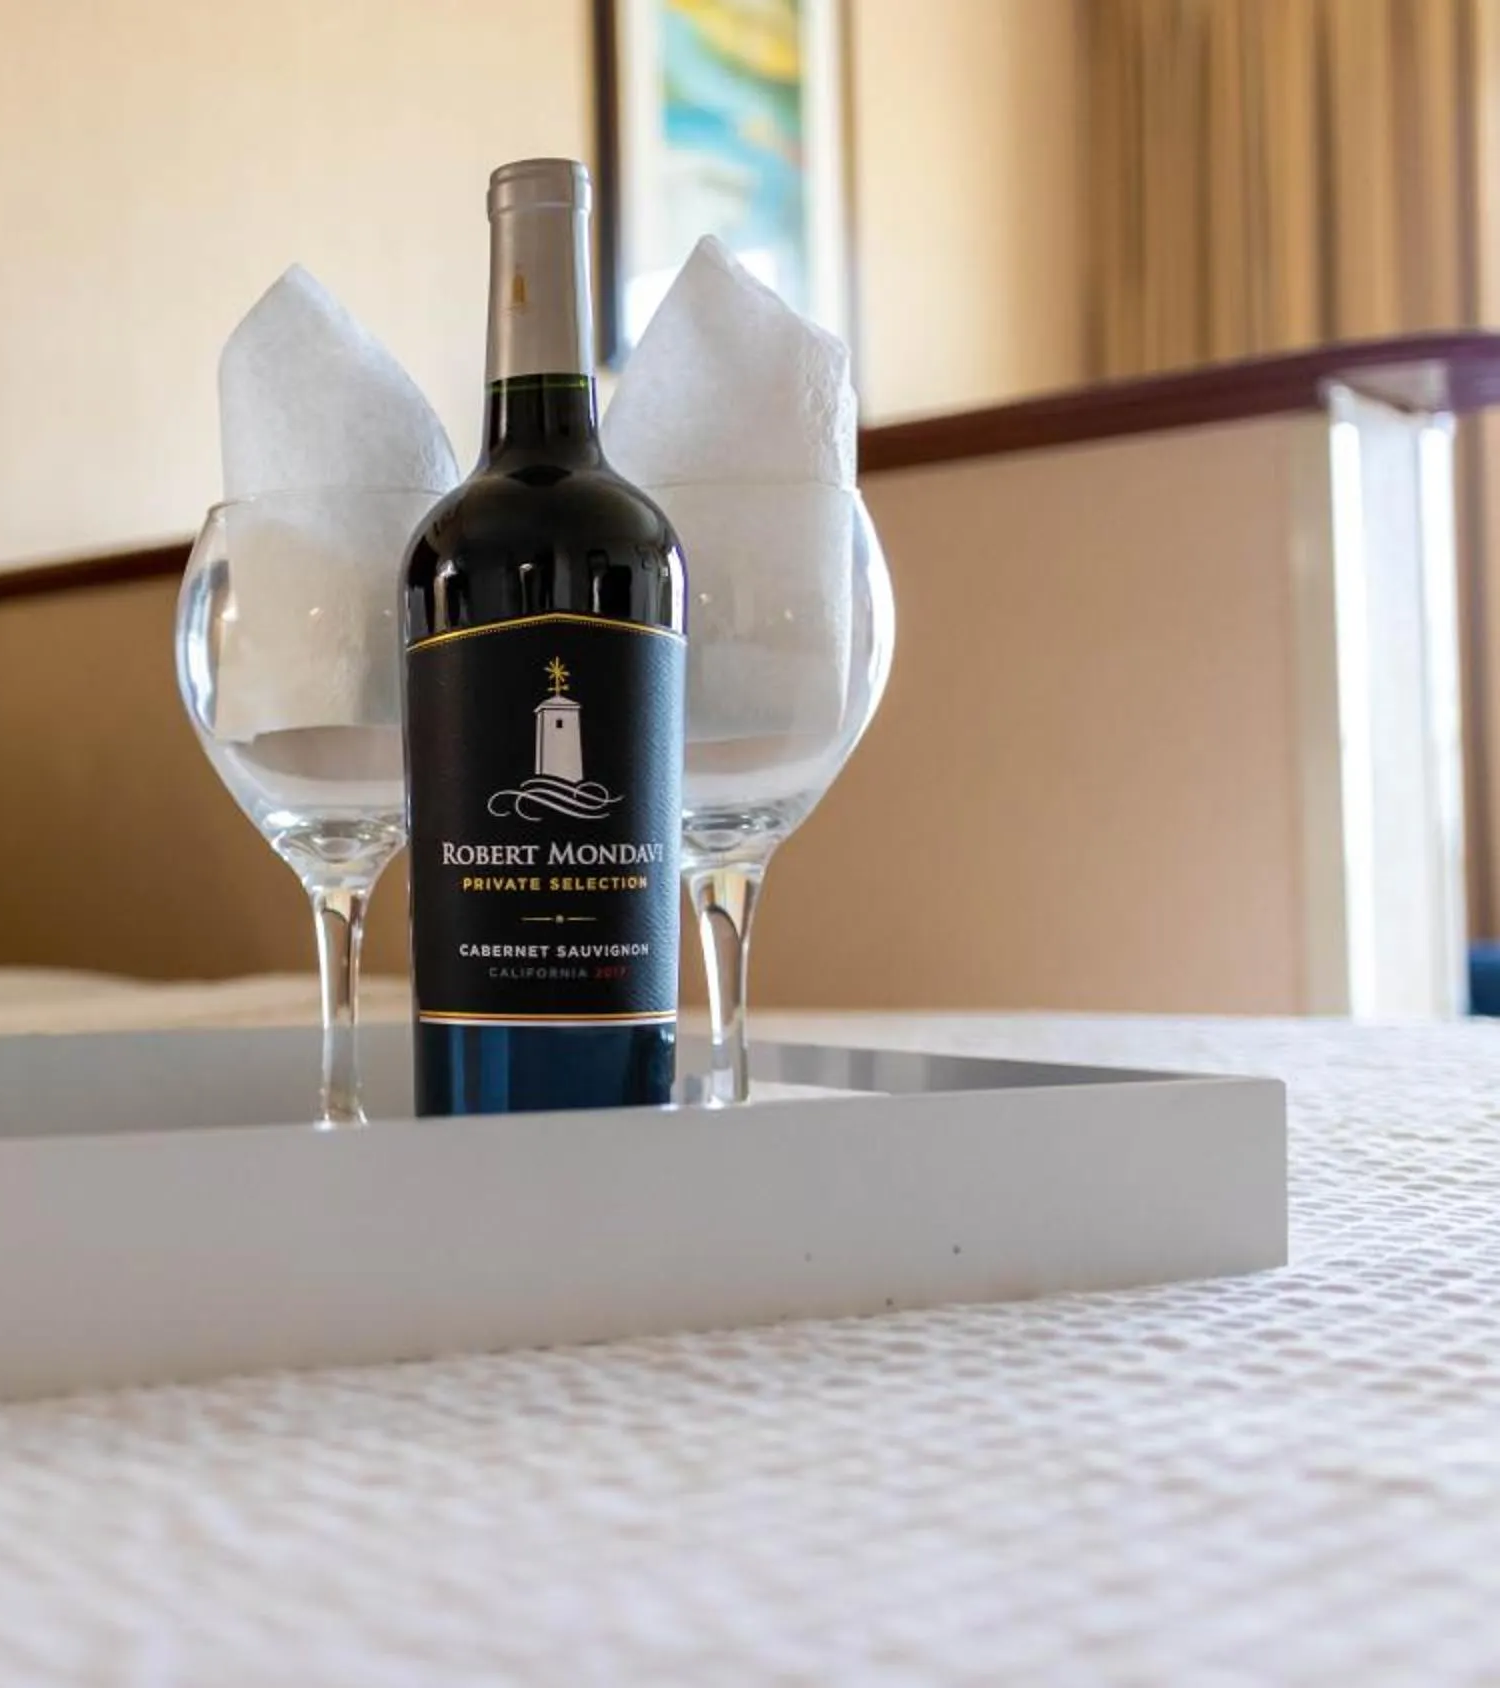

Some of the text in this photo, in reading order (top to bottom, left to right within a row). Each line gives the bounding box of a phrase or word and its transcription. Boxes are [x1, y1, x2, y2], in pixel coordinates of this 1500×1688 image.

[442, 841, 664, 865] ROBERT MONDAVI
[463, 876, 647, 891] PRIVATE SELECTION
[459, 943, 649, 958] CABERNET SAUVIGNON
[489, 967, 588, 979] CALIFORNIA
